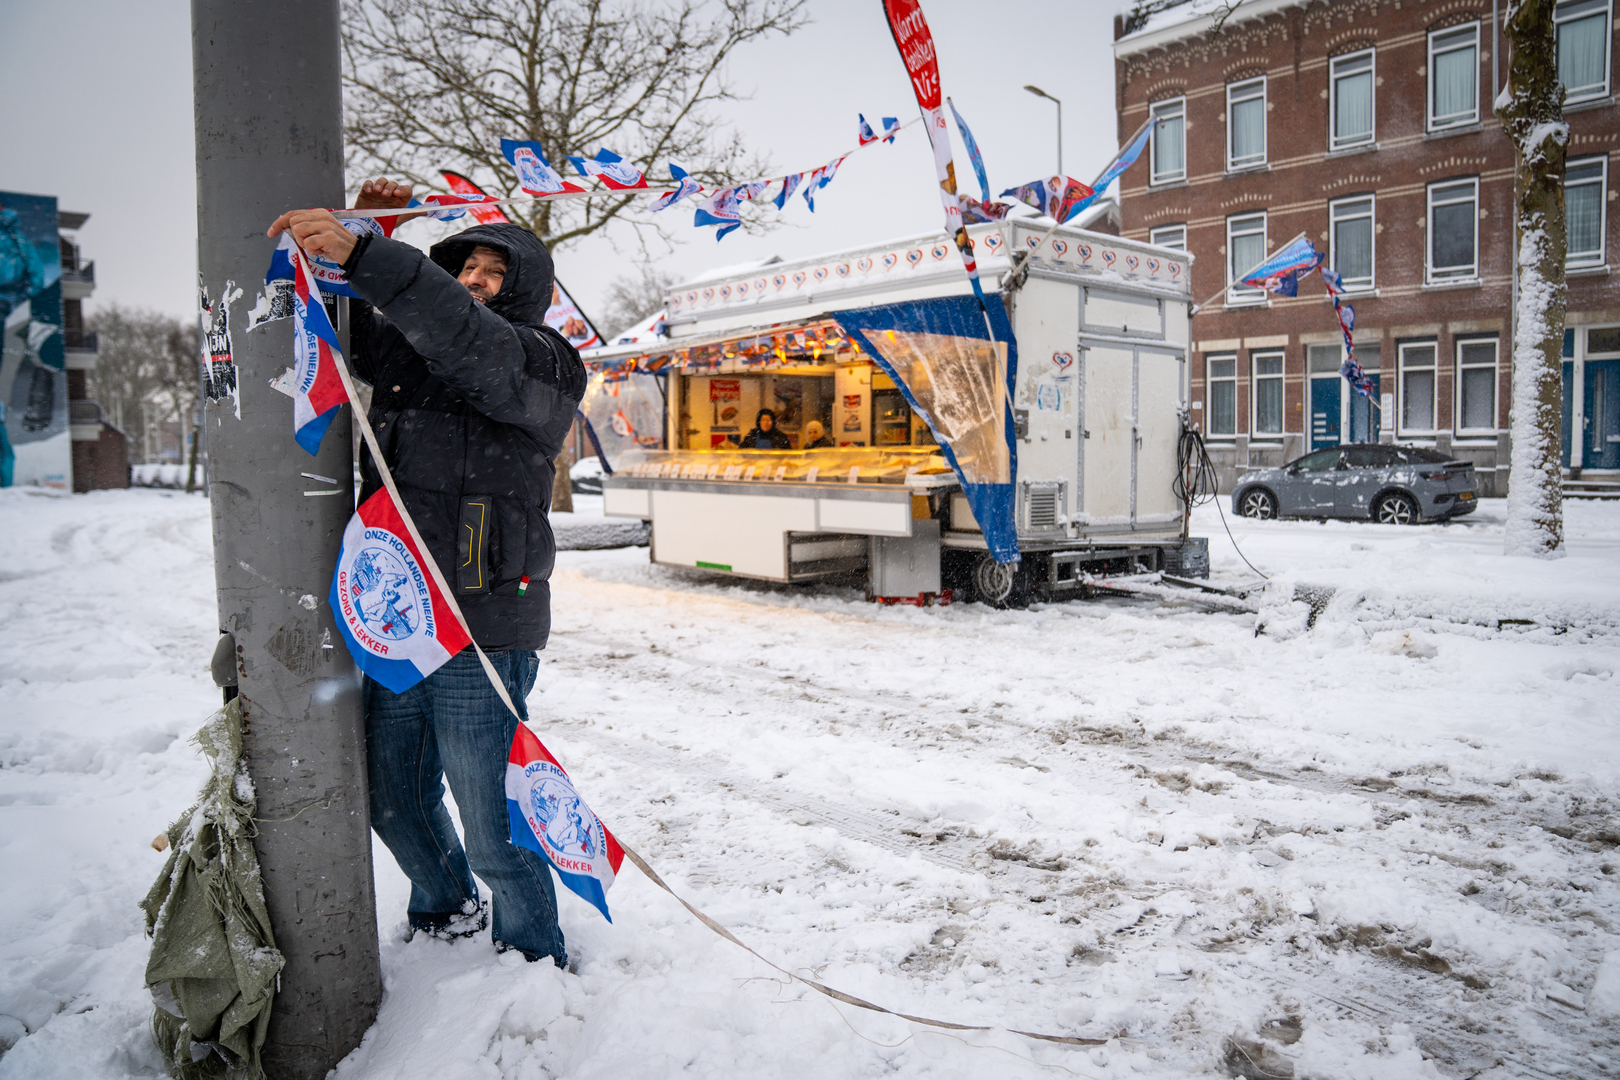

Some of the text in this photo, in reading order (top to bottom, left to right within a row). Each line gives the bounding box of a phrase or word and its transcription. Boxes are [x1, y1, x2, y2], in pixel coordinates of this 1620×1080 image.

[299, 352, 317, 395] NIEUWE
[364, 529, 435, 638] ONZE HOLLANDSE NIEUWE
[339, 570, 389, 656] GEZOND & LEKKER
[525, 762, 548, 778] ONZE
[528, 816, 593, 874] GEZOND & LEKKER
